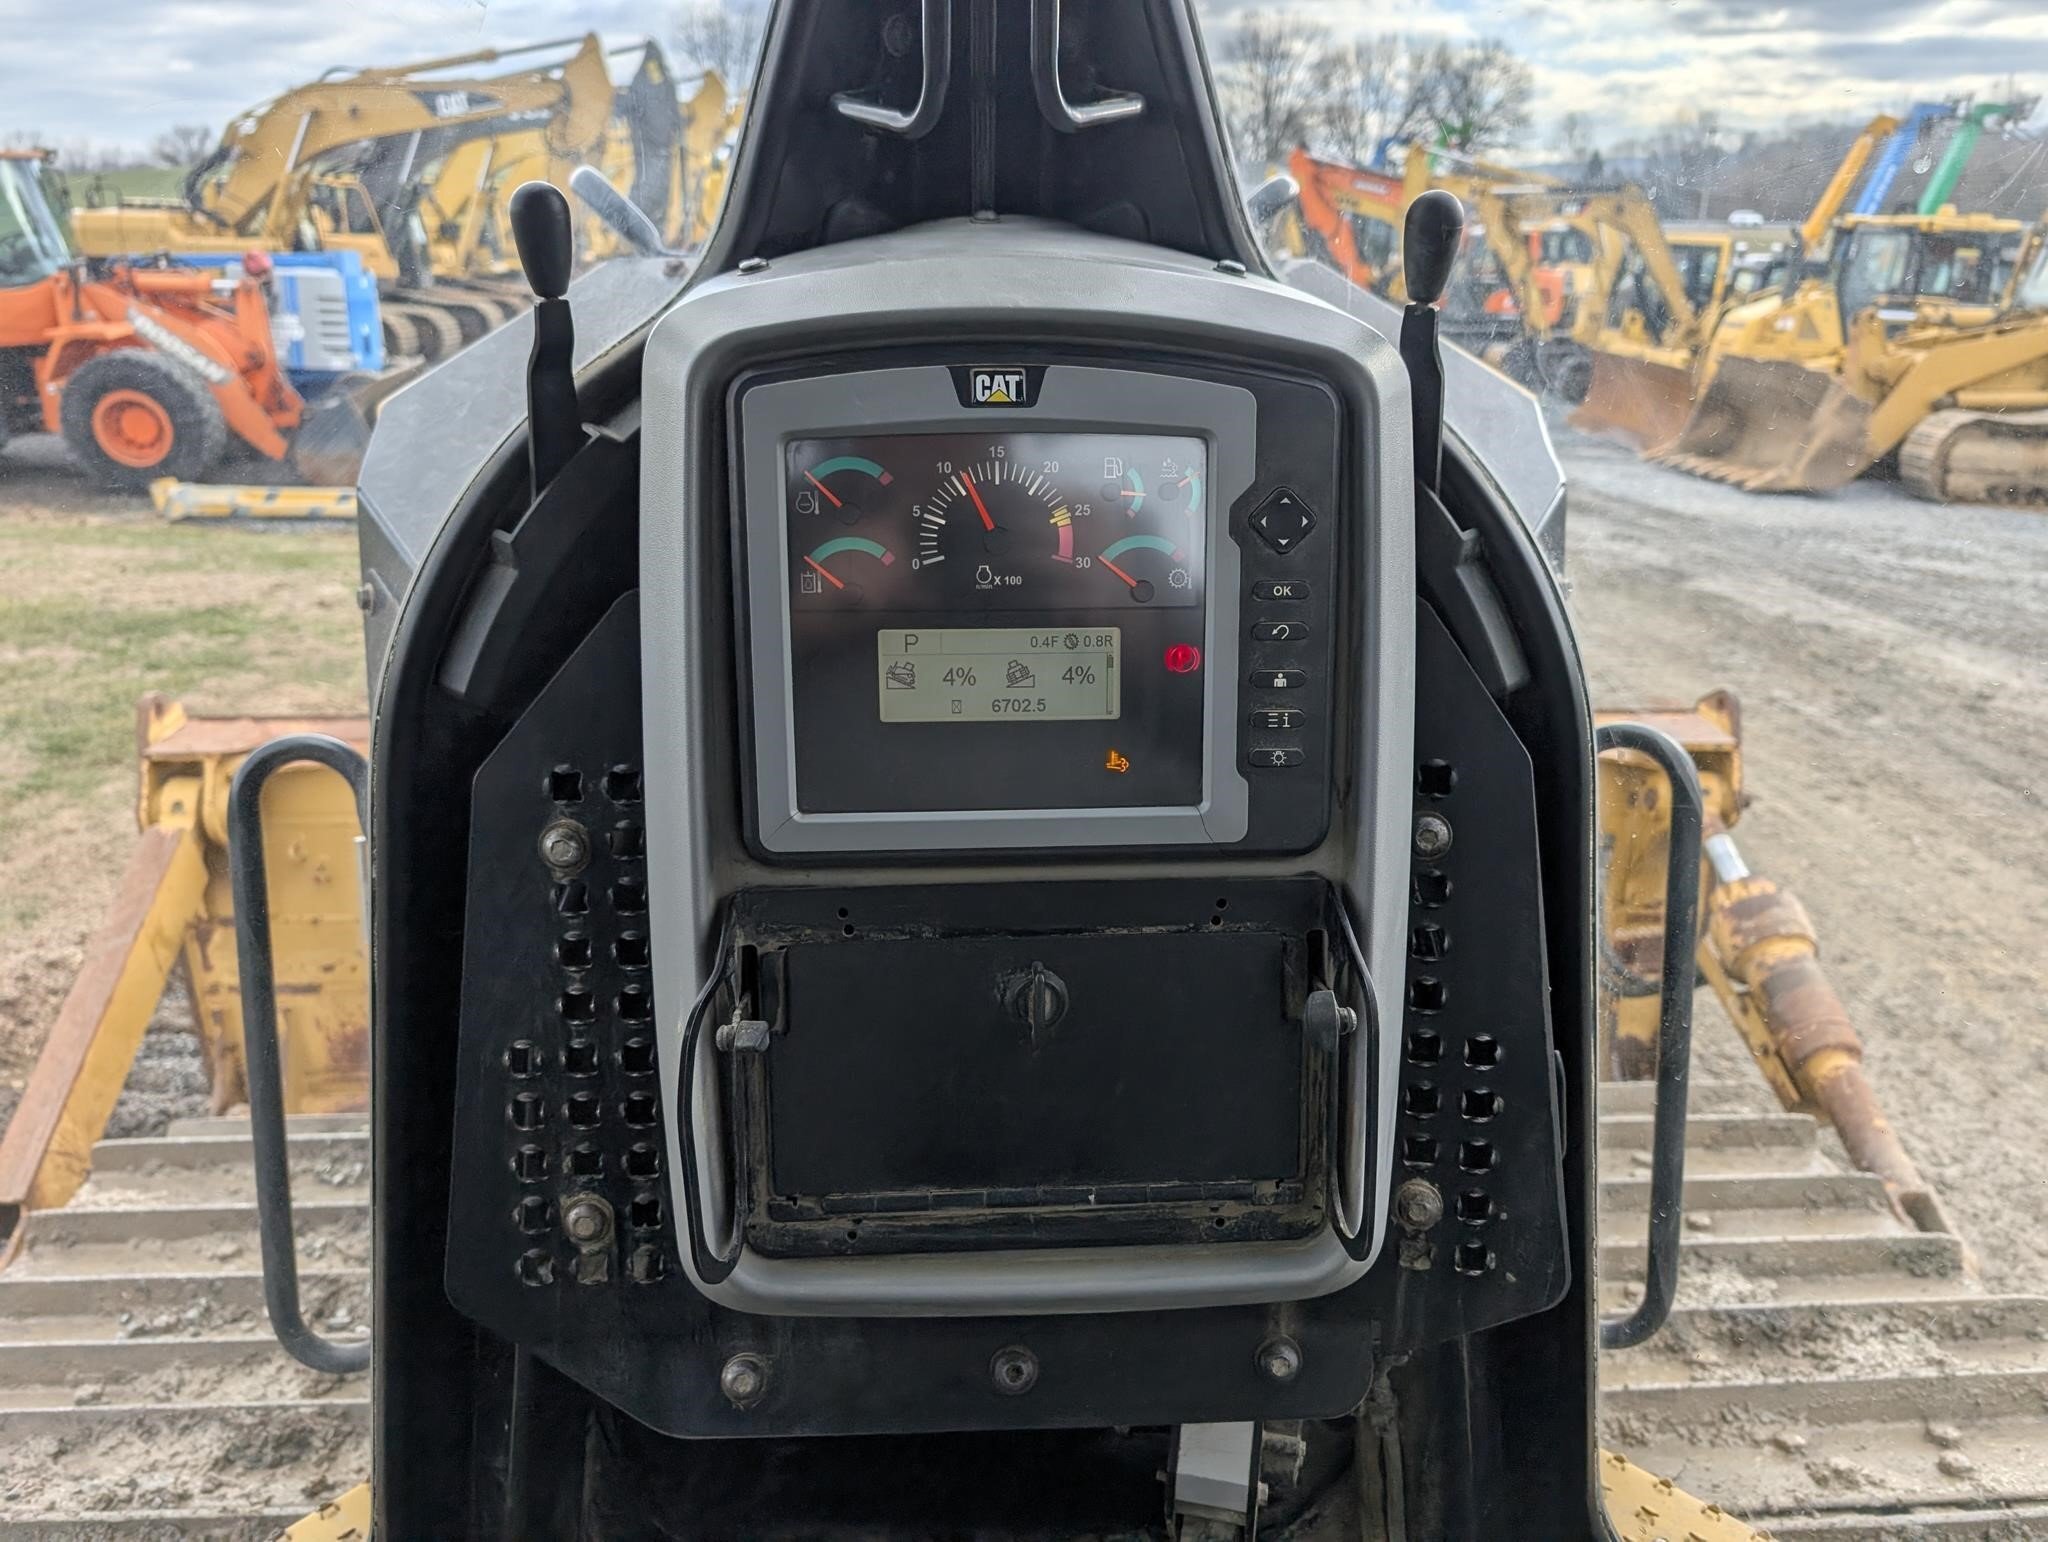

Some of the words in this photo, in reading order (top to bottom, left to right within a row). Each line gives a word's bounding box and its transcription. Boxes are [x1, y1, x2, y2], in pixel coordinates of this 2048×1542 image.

[975, 374, 1020, 403] CAT
[989, 446, 1005, 458] 15
[936, 461, 952, 474] 10
[1043, 461, 1059, 473] 20
[912, 505, 921, 517] 5
[1074, 504, 1091, 516] 25
[912, 559, 920, 570] 0
[1075, 557, 1091, 569] 30
[1004, 575, 1022, 585] 100
[1273, 585, 1292, 596] OK
[904, 633, 919, 653] P
[1030, 636, 1059, 648] 0.4F
[1083, 635, 1114, 648] 0.8R
[942, 667, 977, 687] 4%
[1061, 665, 1096, 685] 4%
[991, 699, 1047, 713] 6702.5
